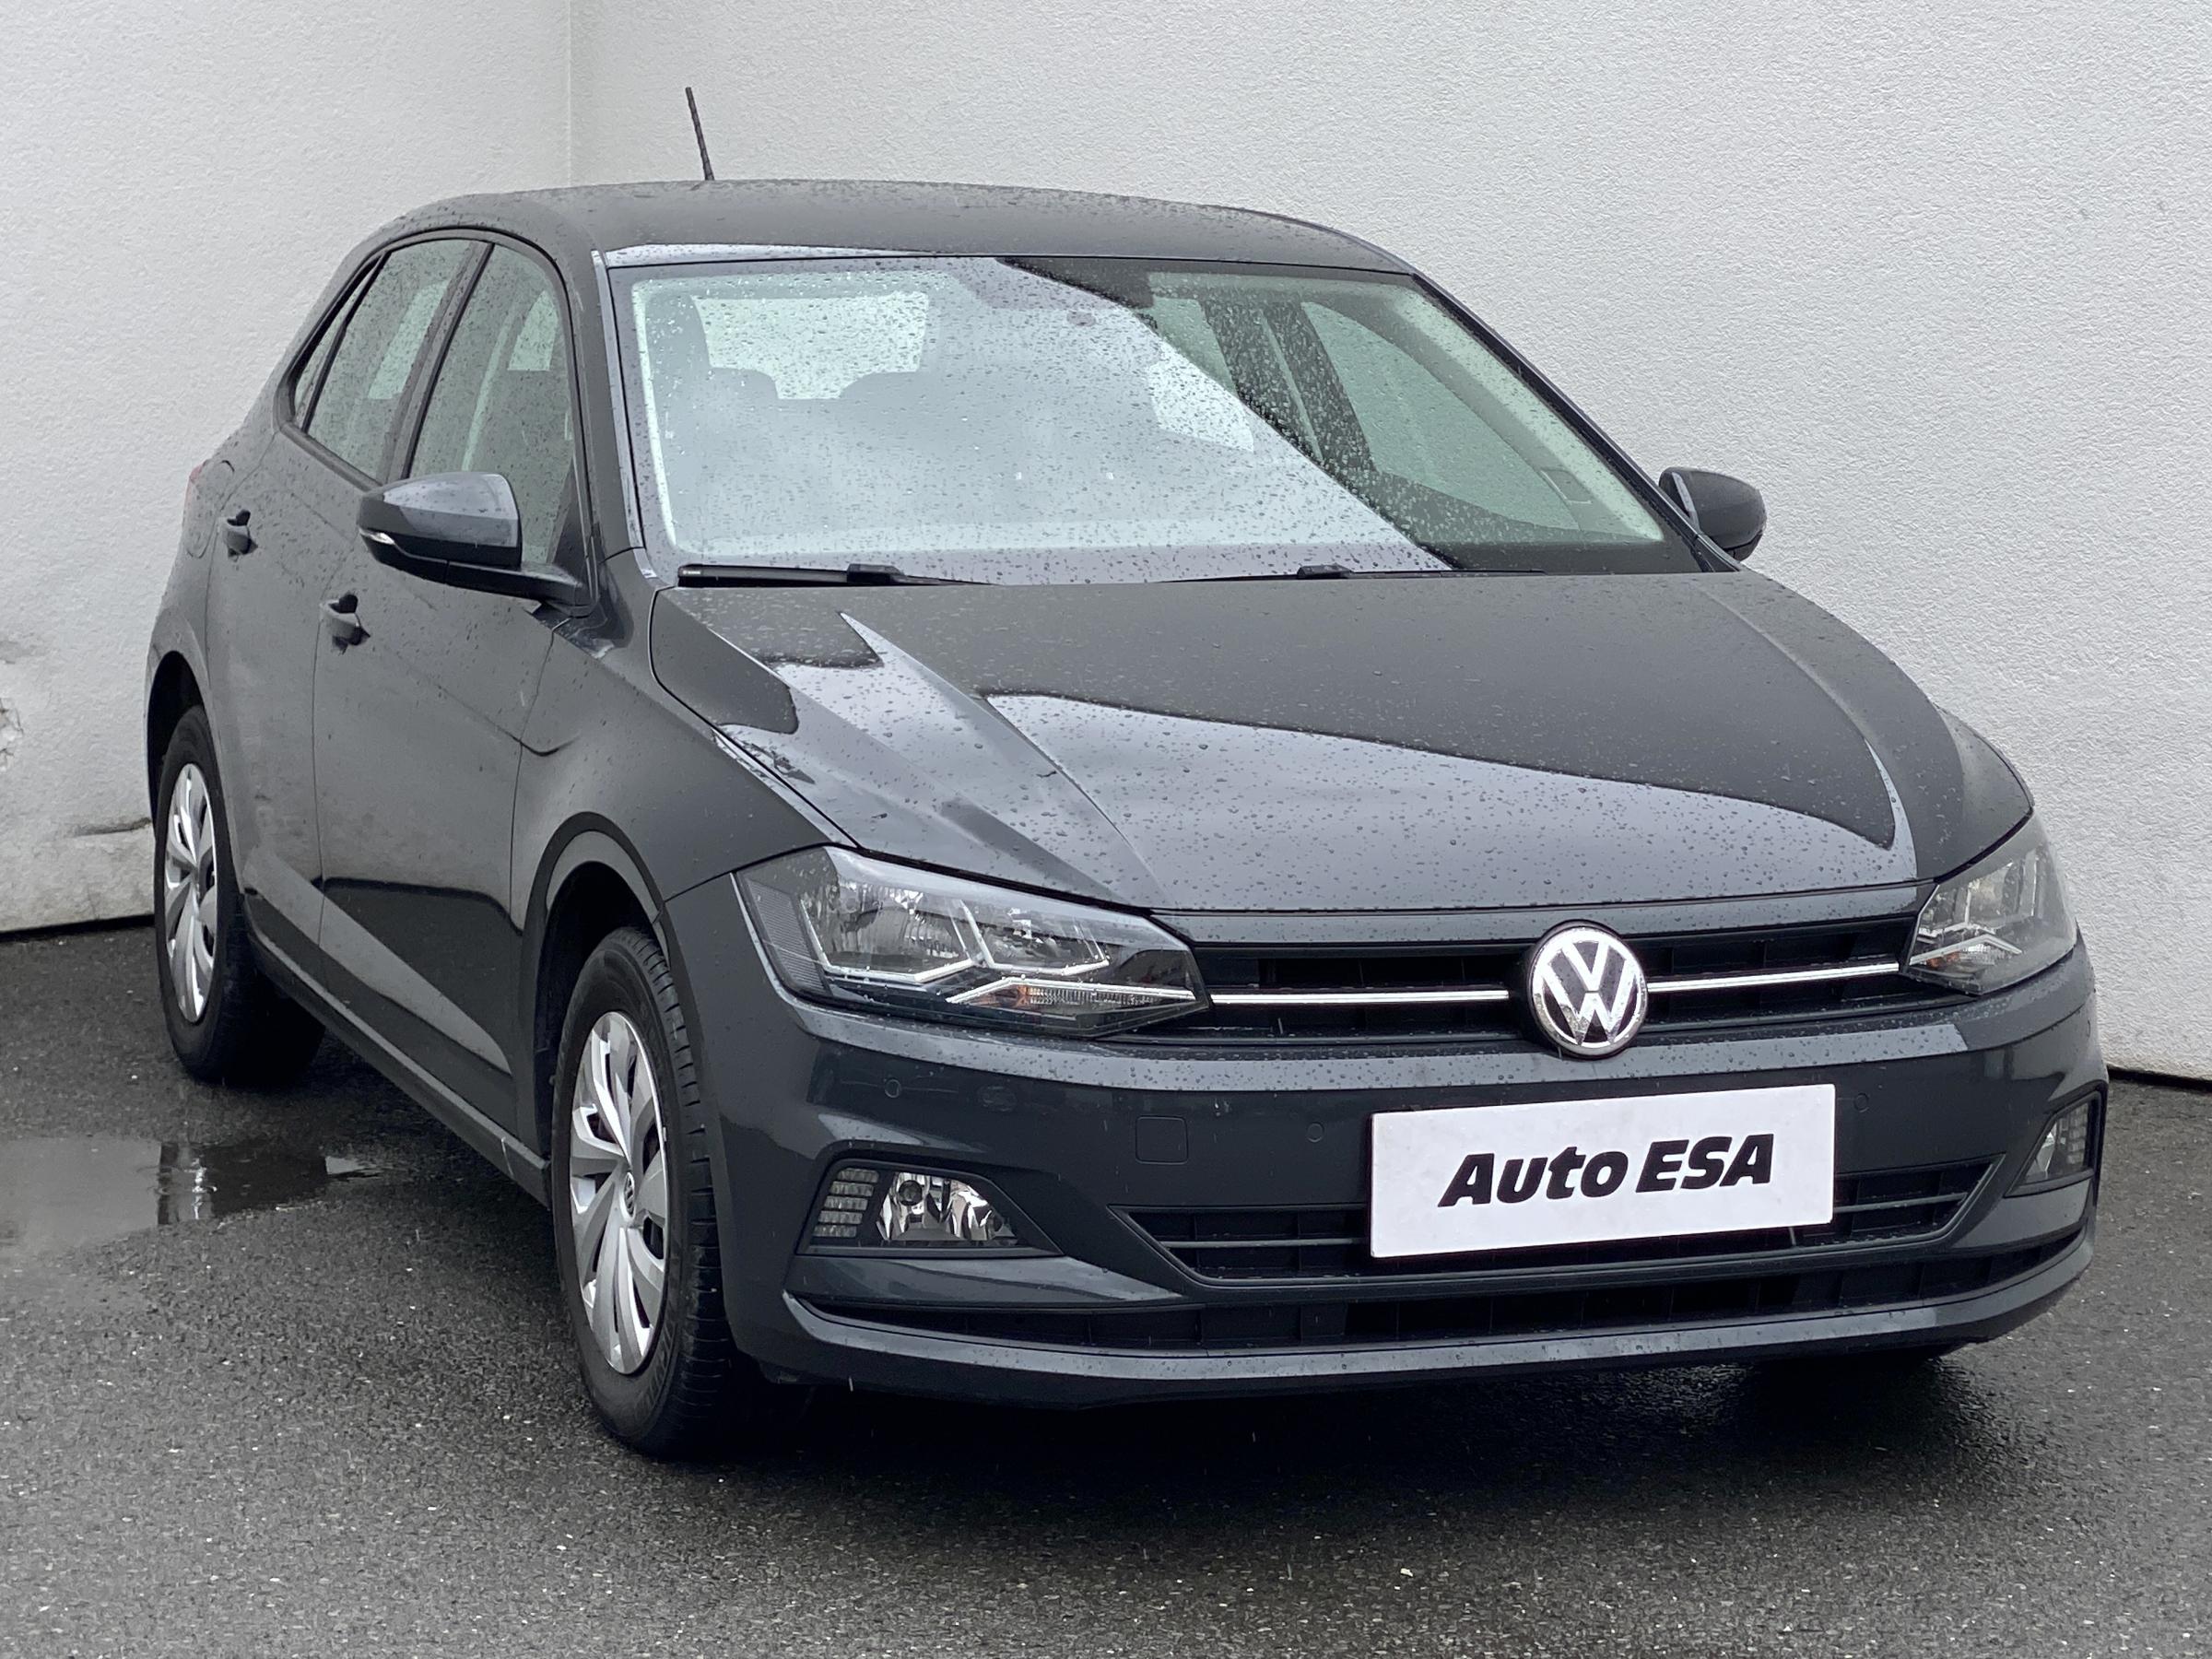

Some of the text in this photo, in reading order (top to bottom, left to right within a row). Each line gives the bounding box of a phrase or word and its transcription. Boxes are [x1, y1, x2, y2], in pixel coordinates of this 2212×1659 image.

[1535, 931, 1644, 1050] VW
[1437, 1134, 1774, 1208] Auto ESA
